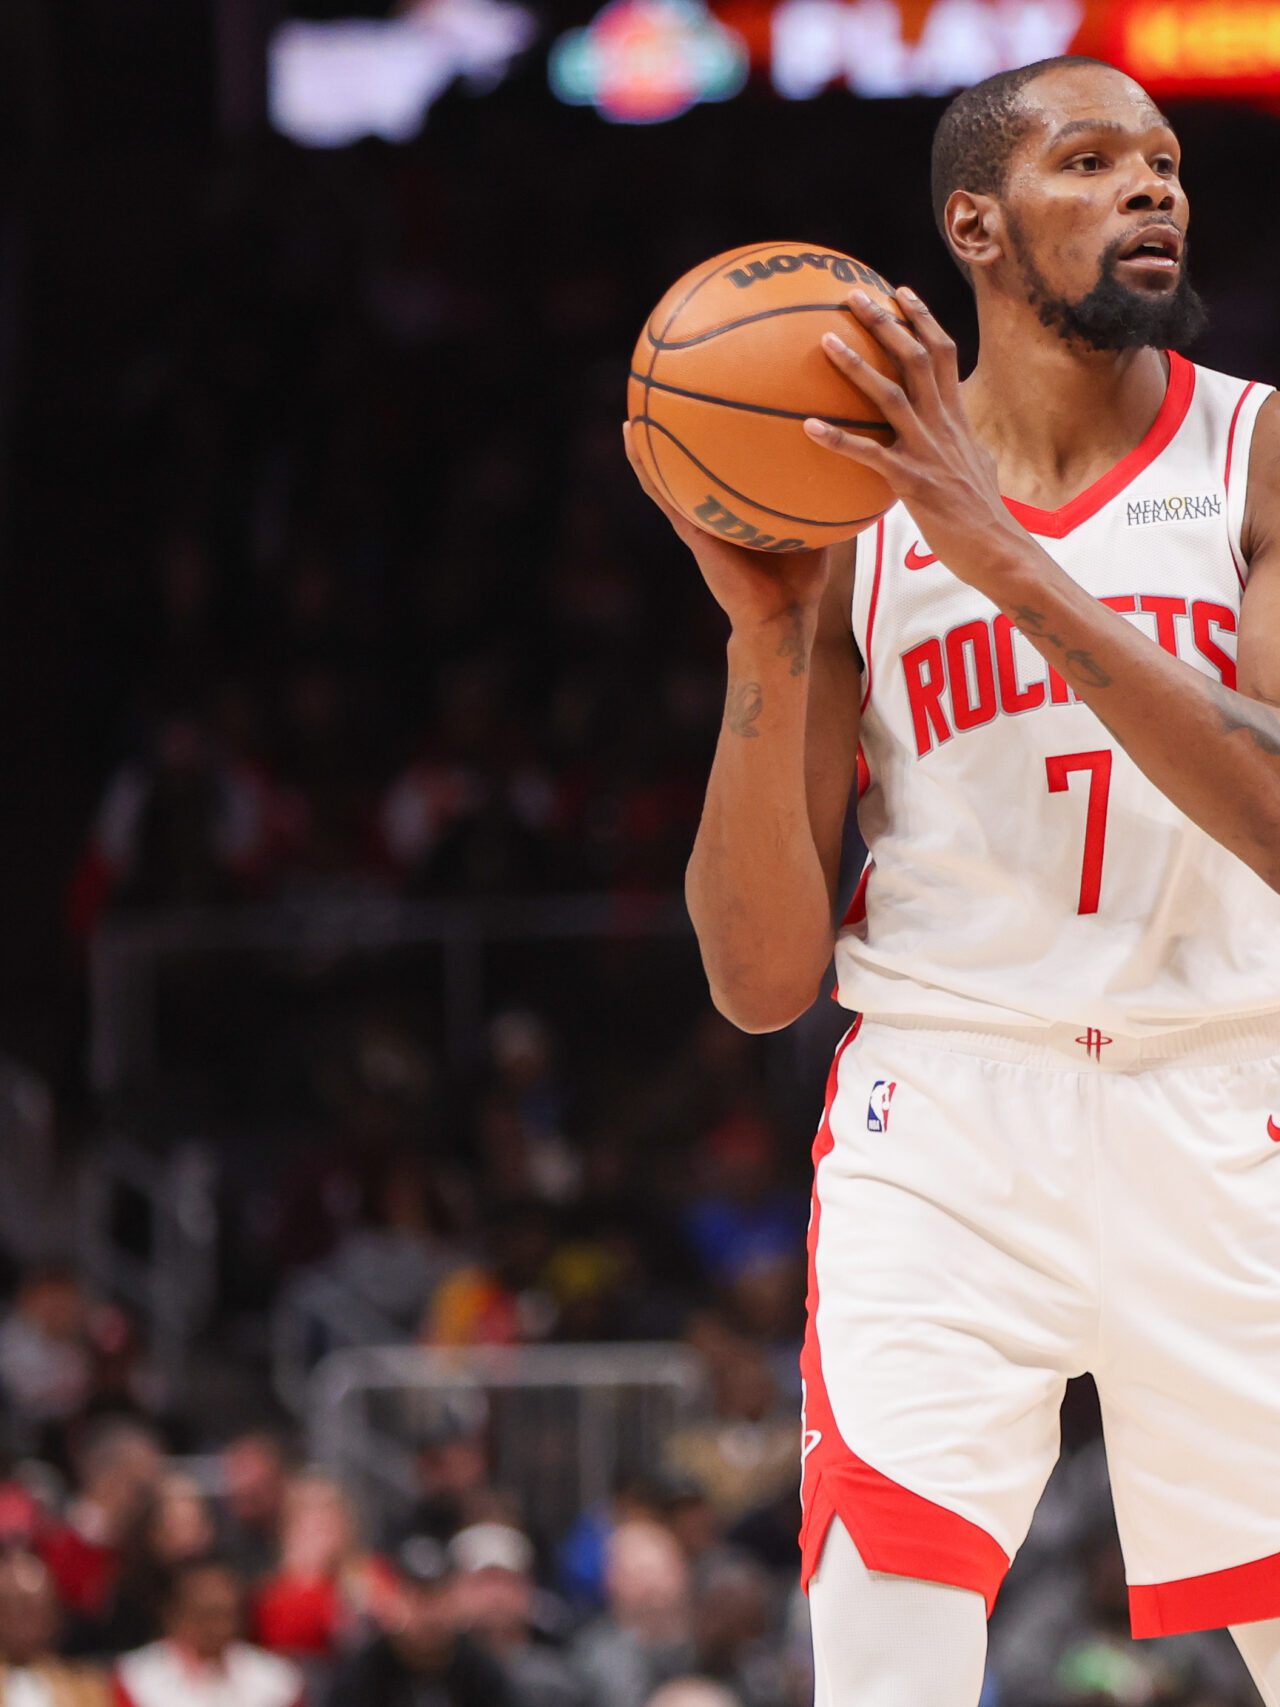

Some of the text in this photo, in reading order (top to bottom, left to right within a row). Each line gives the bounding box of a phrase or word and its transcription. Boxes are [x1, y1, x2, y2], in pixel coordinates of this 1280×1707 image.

[1127, 494, 1221, 515] MEMORIAL
[1127, 504, 1221, 526] HERMANN
[899, 594, 1238, 761] ROCTS
[1044, 749, 1113, 916] 7
